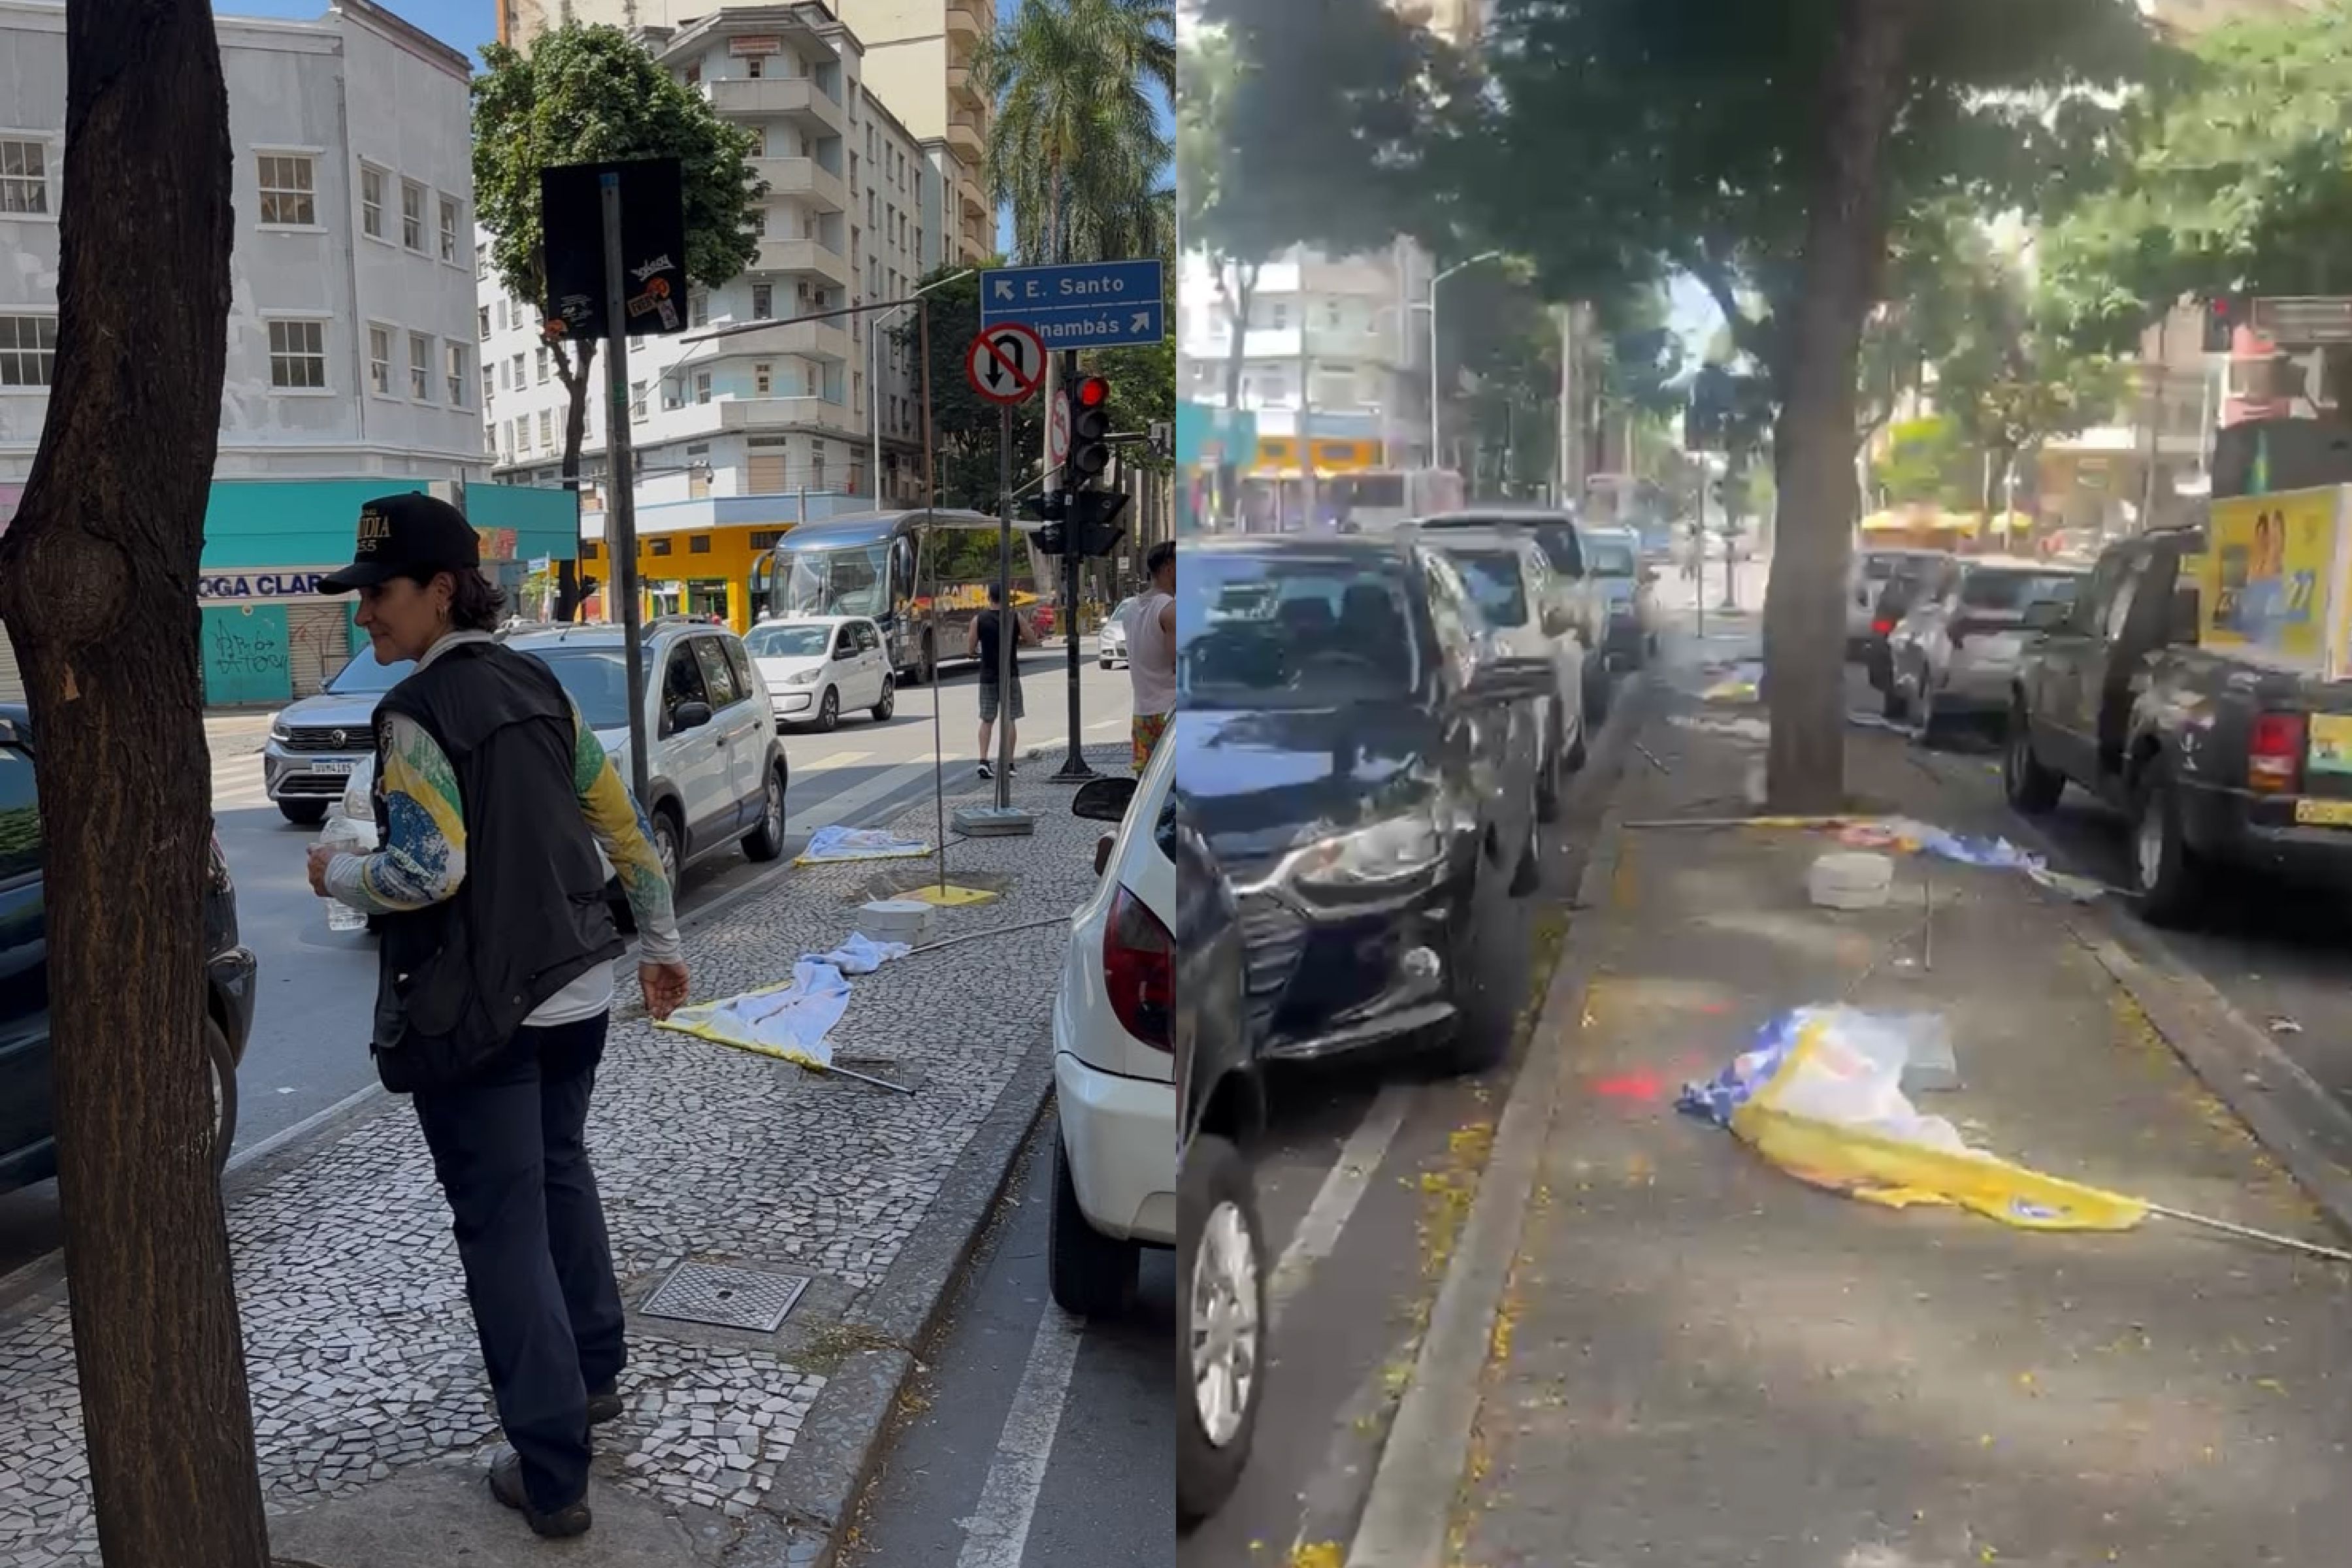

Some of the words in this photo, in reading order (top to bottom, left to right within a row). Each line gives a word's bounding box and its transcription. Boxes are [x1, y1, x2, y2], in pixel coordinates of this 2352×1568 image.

[1026, 280, 1046, 298] E.
[1060, 276, 1124, 294] Santo
[1034, 312, 1119, 337] inambás
[197, 576, 251, 596] OGA
[256, 574, 323, 595] CLAR
